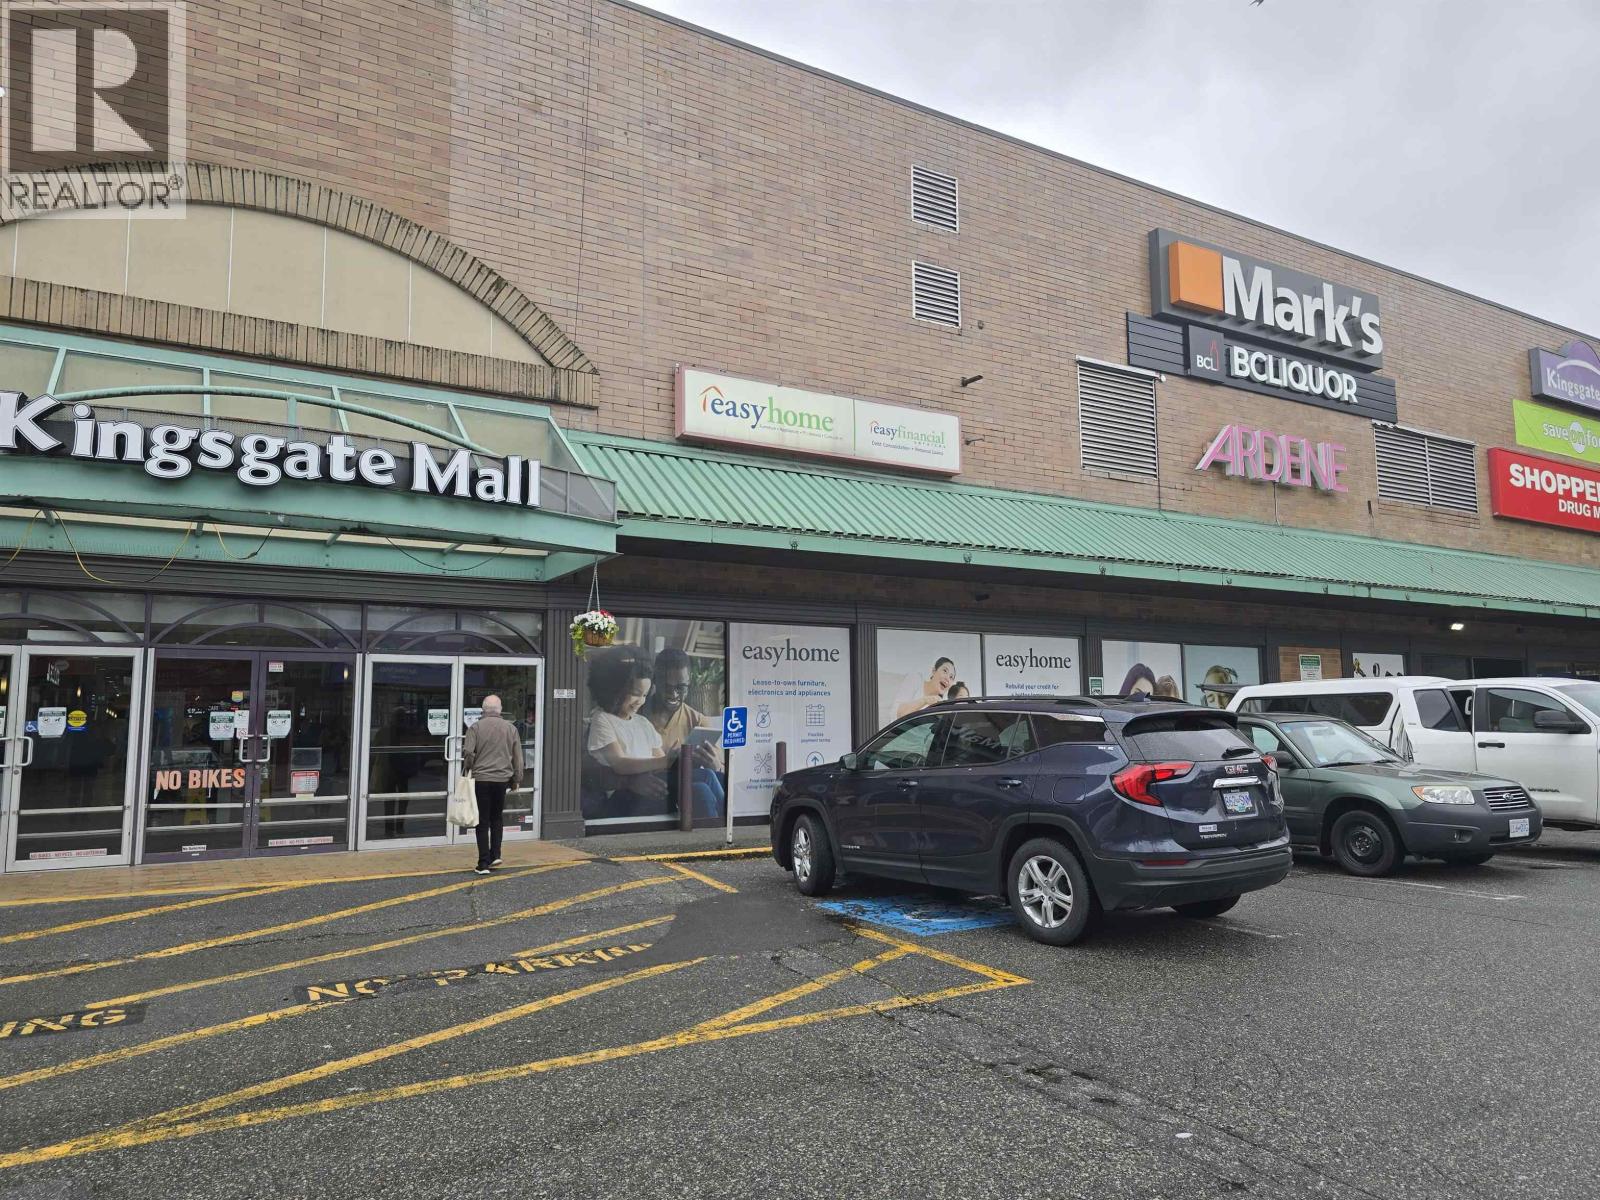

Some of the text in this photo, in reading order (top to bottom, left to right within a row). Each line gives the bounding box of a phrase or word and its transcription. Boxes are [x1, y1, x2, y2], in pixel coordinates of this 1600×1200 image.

[1222, 255, 1383, 354] Mark's
[1196, 354, 1217, 371] BCL
[1230, 345, 1358, 403] BCLIQUOR
[1546, 367, 1600, 400] Kingsgate
[0, 391, 541, 507] Kingsgate Mall
[1195, 424, 1349, 492] ARDENE
[1509, 463, 1600, 503] SHOPPE
[1559, 499, 1591, 517] DRUG
[742, 639, 839, 667] easyhome
[996, 648, 1071, 673] easyhome
[748, 689, 831, 697] electronics and appliances
[752, 679, 796, 687] Lease-to-own
[156, 768, 246, 790] NO BIKES
